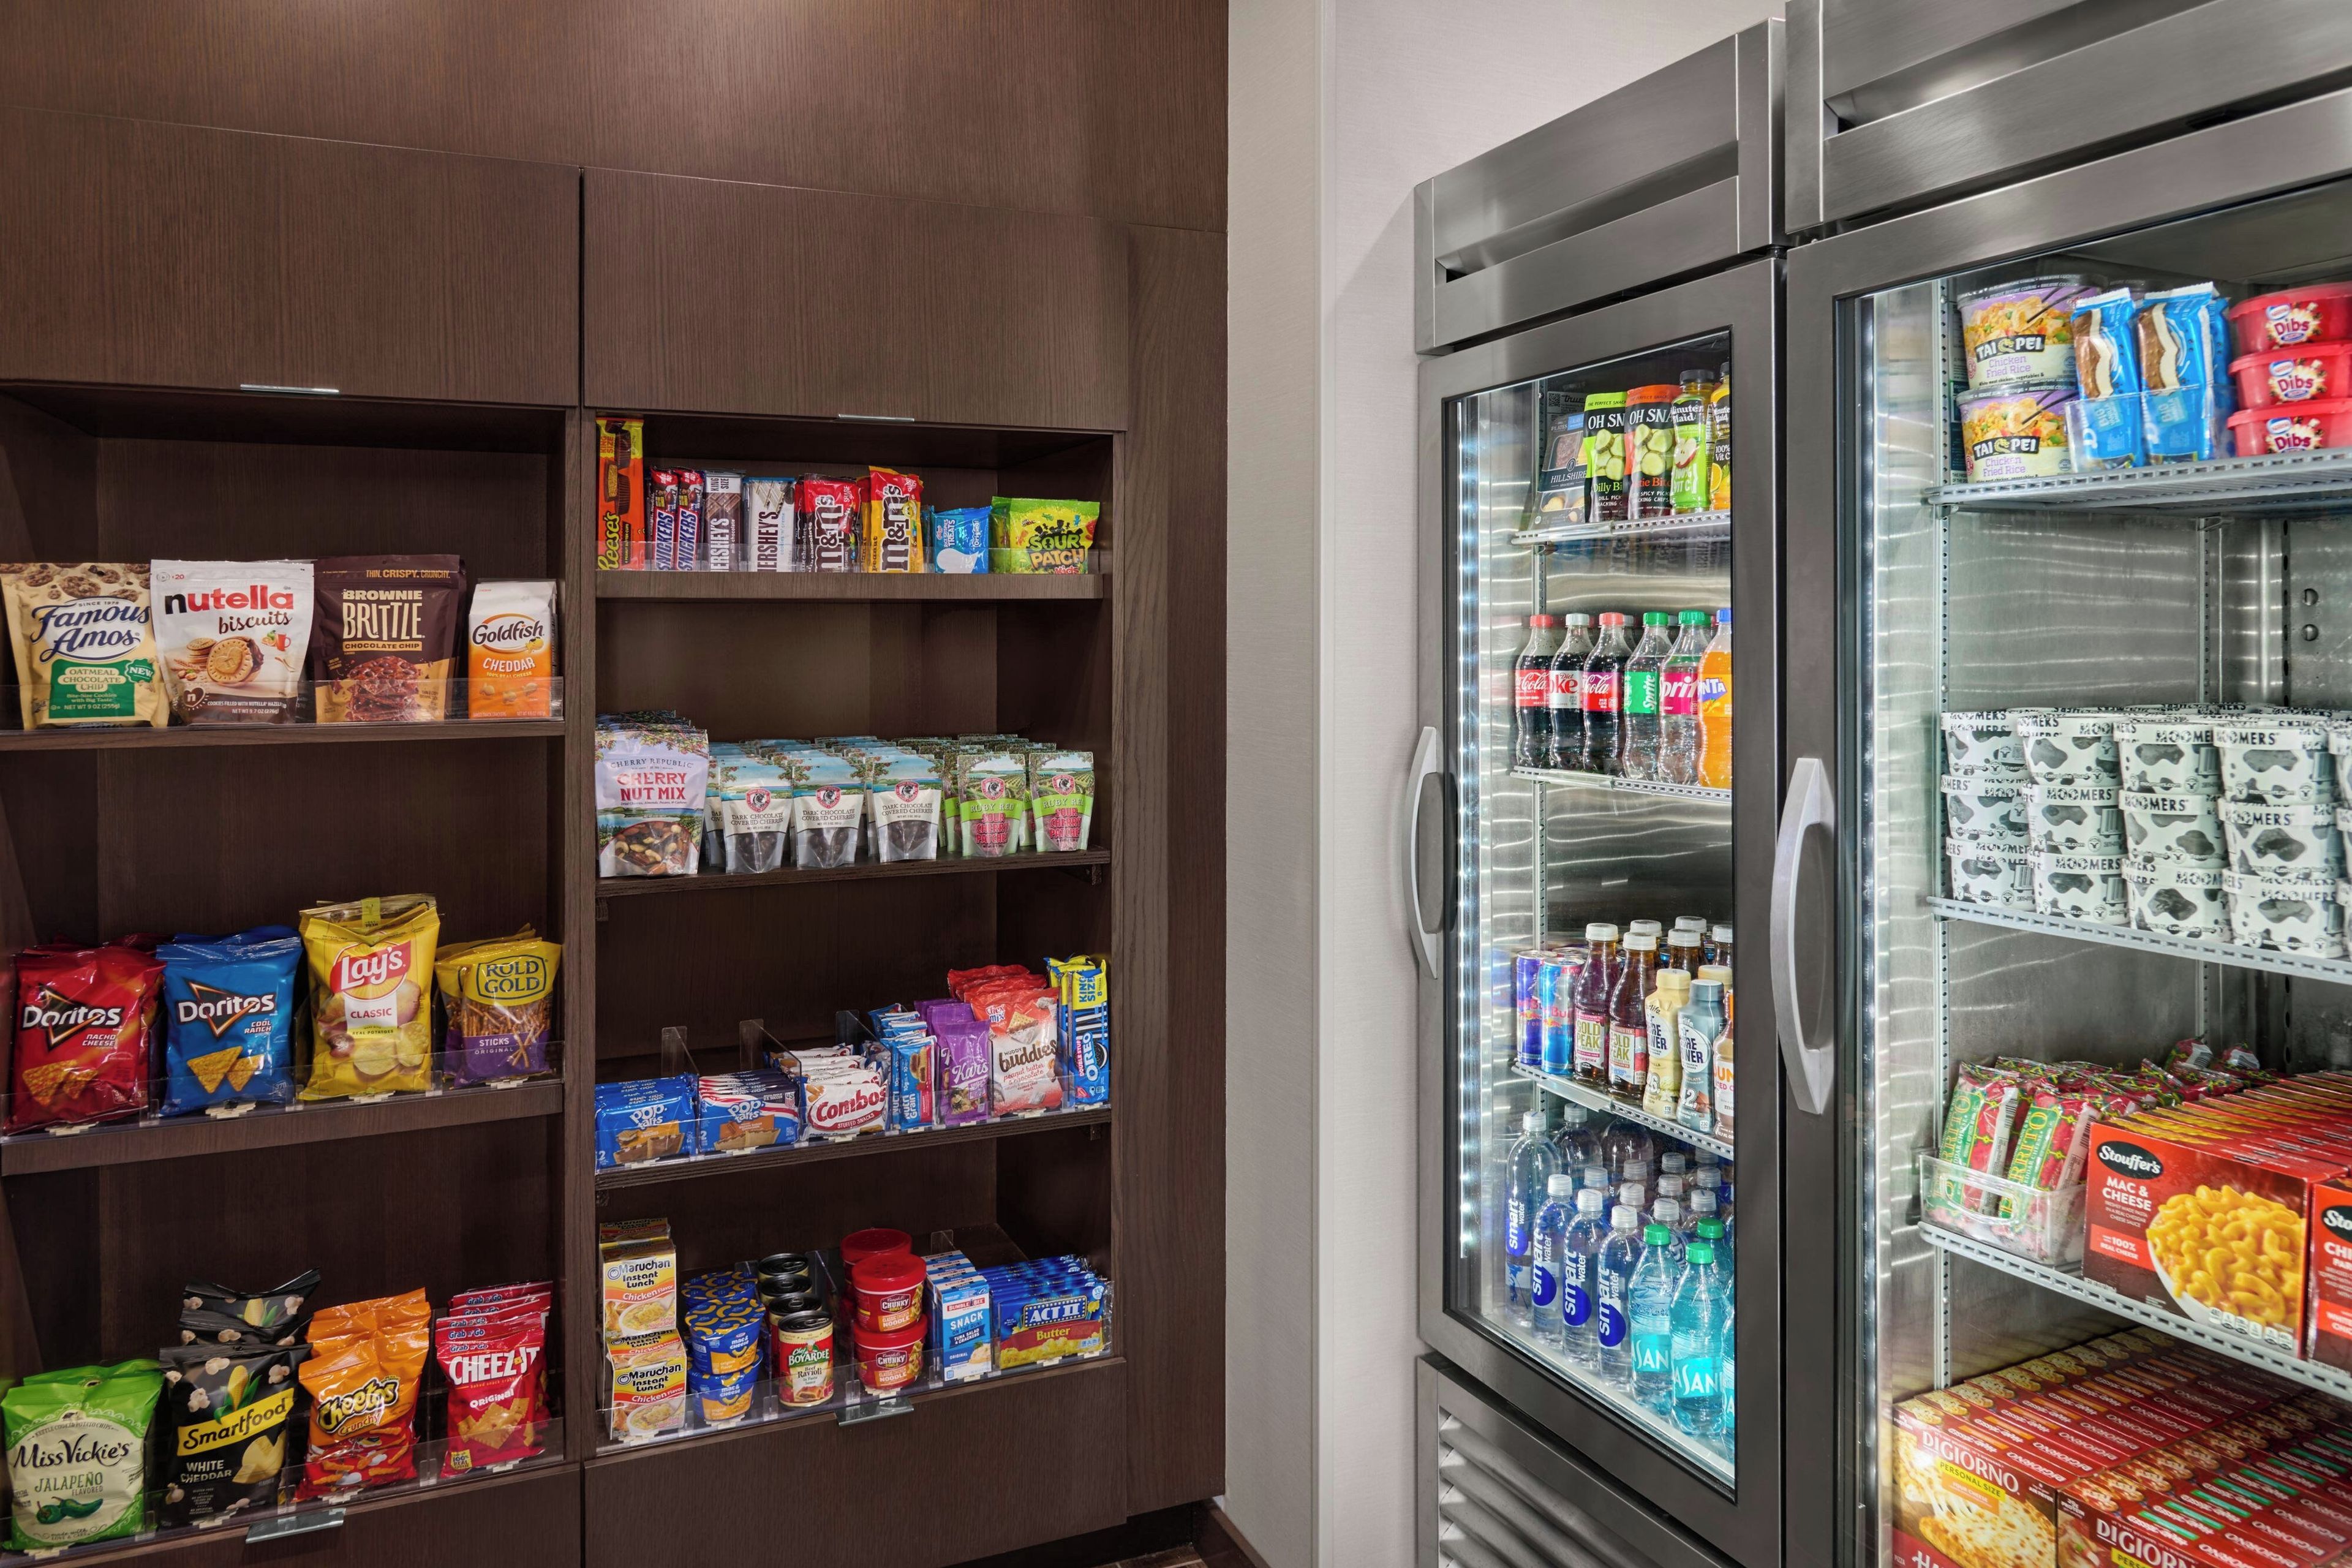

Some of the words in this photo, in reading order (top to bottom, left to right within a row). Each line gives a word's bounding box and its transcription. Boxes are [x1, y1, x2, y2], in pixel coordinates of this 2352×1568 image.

[2274, 318, 2310, 336] Dibs
[1976, 342, 1997, 360] TAI
[2016, 337, 2042, 350] PEI
[1989, 356, 2026, 368] Chicken
[1986, 368, 2007, 379] Fried
[2010, 364, 2031, 374] Rice
[2277, 375, 2314, 392] Dibs
[1588, 415, 1604, 429] OH
[1629, 410, 1645, 424] OH
[1973, 442, 1993, 458] TAI
[2011, 438, 2037, 451] PEI
[2274, 433, 2311, 450] Dibs
[1551, 471, 1586, 483] HILLSHIRE
[1983, 466, 2003, 477] Fried
[2005, 466, 2026, 475] Rice
[710, 477, 719, 491] KING
[720, 477, 729, 489] SIZE
[598, 510, 620, 570] Reese's
[656, 511, 674, 571] SNICKERS
[677, 510, 697, 570] SNICKERS
[1029, 535, 1081, 551] SOUR
[1030, 548, 1085, 569] PATCH
[383, 570, 420, 578] CRISPY.
[420, 570, 451, 579] CRUNCHY.
[164, 585, 294, 615] nutella
[342, 590, 423, 600] BROWNIE
[31, 605, 151, 643] Famous
[219, 611, 293, 635] biscuits
[342, 602, 423, 640] BRITTLE
[472, 620, 543, 645] Goldfish
[39, 627, 141, 663] Amos
[129, 666, 154, 678] NEW
[483, 657, 536, 673] CHEDDAR
[1643, 674, 1657, 710] Sprite
[610, 758, 646, 768] CHERRY
[650, 758, 693, 768] REPUBLIC
[617, 772, 687, 785] CHERRY
[620, 787, 654, 801] NUT
[658, 787, 686, 800] MIX
[2047, 788, 2113, 801] MOOMERS
[970, 803, 996, 813] RUBY
[2125, 796, 2185, 812] MOOMERS
[981, 813, 1005, 823] SOUR
[1055, 807, 1079, 818] SOUR
[976, 823, 1010, 833] CHERRY
[2056, 858, 2120, 871] MOOMERS
[341, 946, 404, 990] Lay's
[486, 960, 539, 978] ROLD
[484, 977, 540, 993] GOLD
[178, 994, 275, 1023] Doritos
[350, 1008, 392, 1019] CLASSIC
[986, 1003, 1005, 1016] Chex
[23, 1007, 123, 1028] Doritos
[1577, 1021, 1600, 1033] GOLD
[479, 1038, 510, 1047] STICKS
[1577, 1033, 1600, 1049] PEAK
[998, 1039, 1057, 1072] buddies
[1083, 1032, 1098, 1082] OREO
[952, 1060, 990, 1084] Kar's
[1003, 1067, 1025, 1083] peanut
[1026, 1062, 1045, 1071] butter
[816, 1088, 886, 1122] Combos
[908, 1093, 918, 1119] Grain
[837, 1120, 856, 1129] STUFFED
[857, 1112, 875, 1125] SNACKS
[2099, 1145, 2162, 1175] Stouffer's
[2106, 1176, 2136, 1194] MAC
[2139, 1185, 2149, 1198] &
[2102, 1187, 2152, 1212] CHEESE
[1510, 1199, 1518, 1250] smart
[618, 1259, 671, 1273] Maruchan
[1532, 1229, 1544, 1300] smart
[1578, 1253, 1587, 1281] water
[622, 1271, 658, 1282] Instant
[627, 1278, 655, 1289] Lunch
[1564, 1250, 1577, 1316] smart
[622, 1289, 658, 1302] Chicken
[658, 1284, 674, 1293] Flavor
[1610, 1272, 1619, 1300] water
[466, 1297, 483, 1306] Grab
[881, 1298, 910, 1310] CHUNKY
[949, 1302, 970, 1311] BUMBLE
[1598, 1266, 1610, 1337] smart
[950, 1310, 984, 1330] SNACK
[1030, 1306, 1061, 1324] ACT
[1062, 1302, 1080, 1317] II
[883, 1316, 910, 1328] NOODLE
[449, 1330, 467, 1339] Grab
[959, 1333, 980, 1344] CRACKERS
[966, 1328, 980, 1337] SALAD
[1036, 1327, 1071, 1341] Butter
[788, 1348, 830, 1366] BOYARDEE
[877, 1354, 906, 1365] CHUNKY
[628, 1363, 682, 1379] Maruchan
[797, 1368, 823, 1379] Ravioli
[879, 1371, 908, 1382] NOODLE
[632, 1375, 669, 1387] Instant
[636, 1382, 665, 1392] Lunch
[631, 1392, 667, 1403] Chicken
[667, 1387, 684, 1396] Flavor
[318, 1379, 398, 1432] Cheetos
[183, 1397, 287, 1450] Smartfood
[338, 1414, 381, 1436] Crunchy
[13, 1443, 62, 1468] Miss
[59, 1433, 130, 1467] Vickie's
[186, 1460, 225, 1472] WHITE
[1923, 1431, 2021, 1494] DIGIORNO
[2006, 1450, 2067, 1482] DIGIORNO
[34, 1471, 104, 1493] JALAPEÑO
[180, 1469, 232, 1483] CHEDDAR
[1940, 1461, 1982, 1492] PERSONAL
[1983, 1484, 2002, 1498] SIZE
[72, 1485, 104, 1496] FLAVORED
